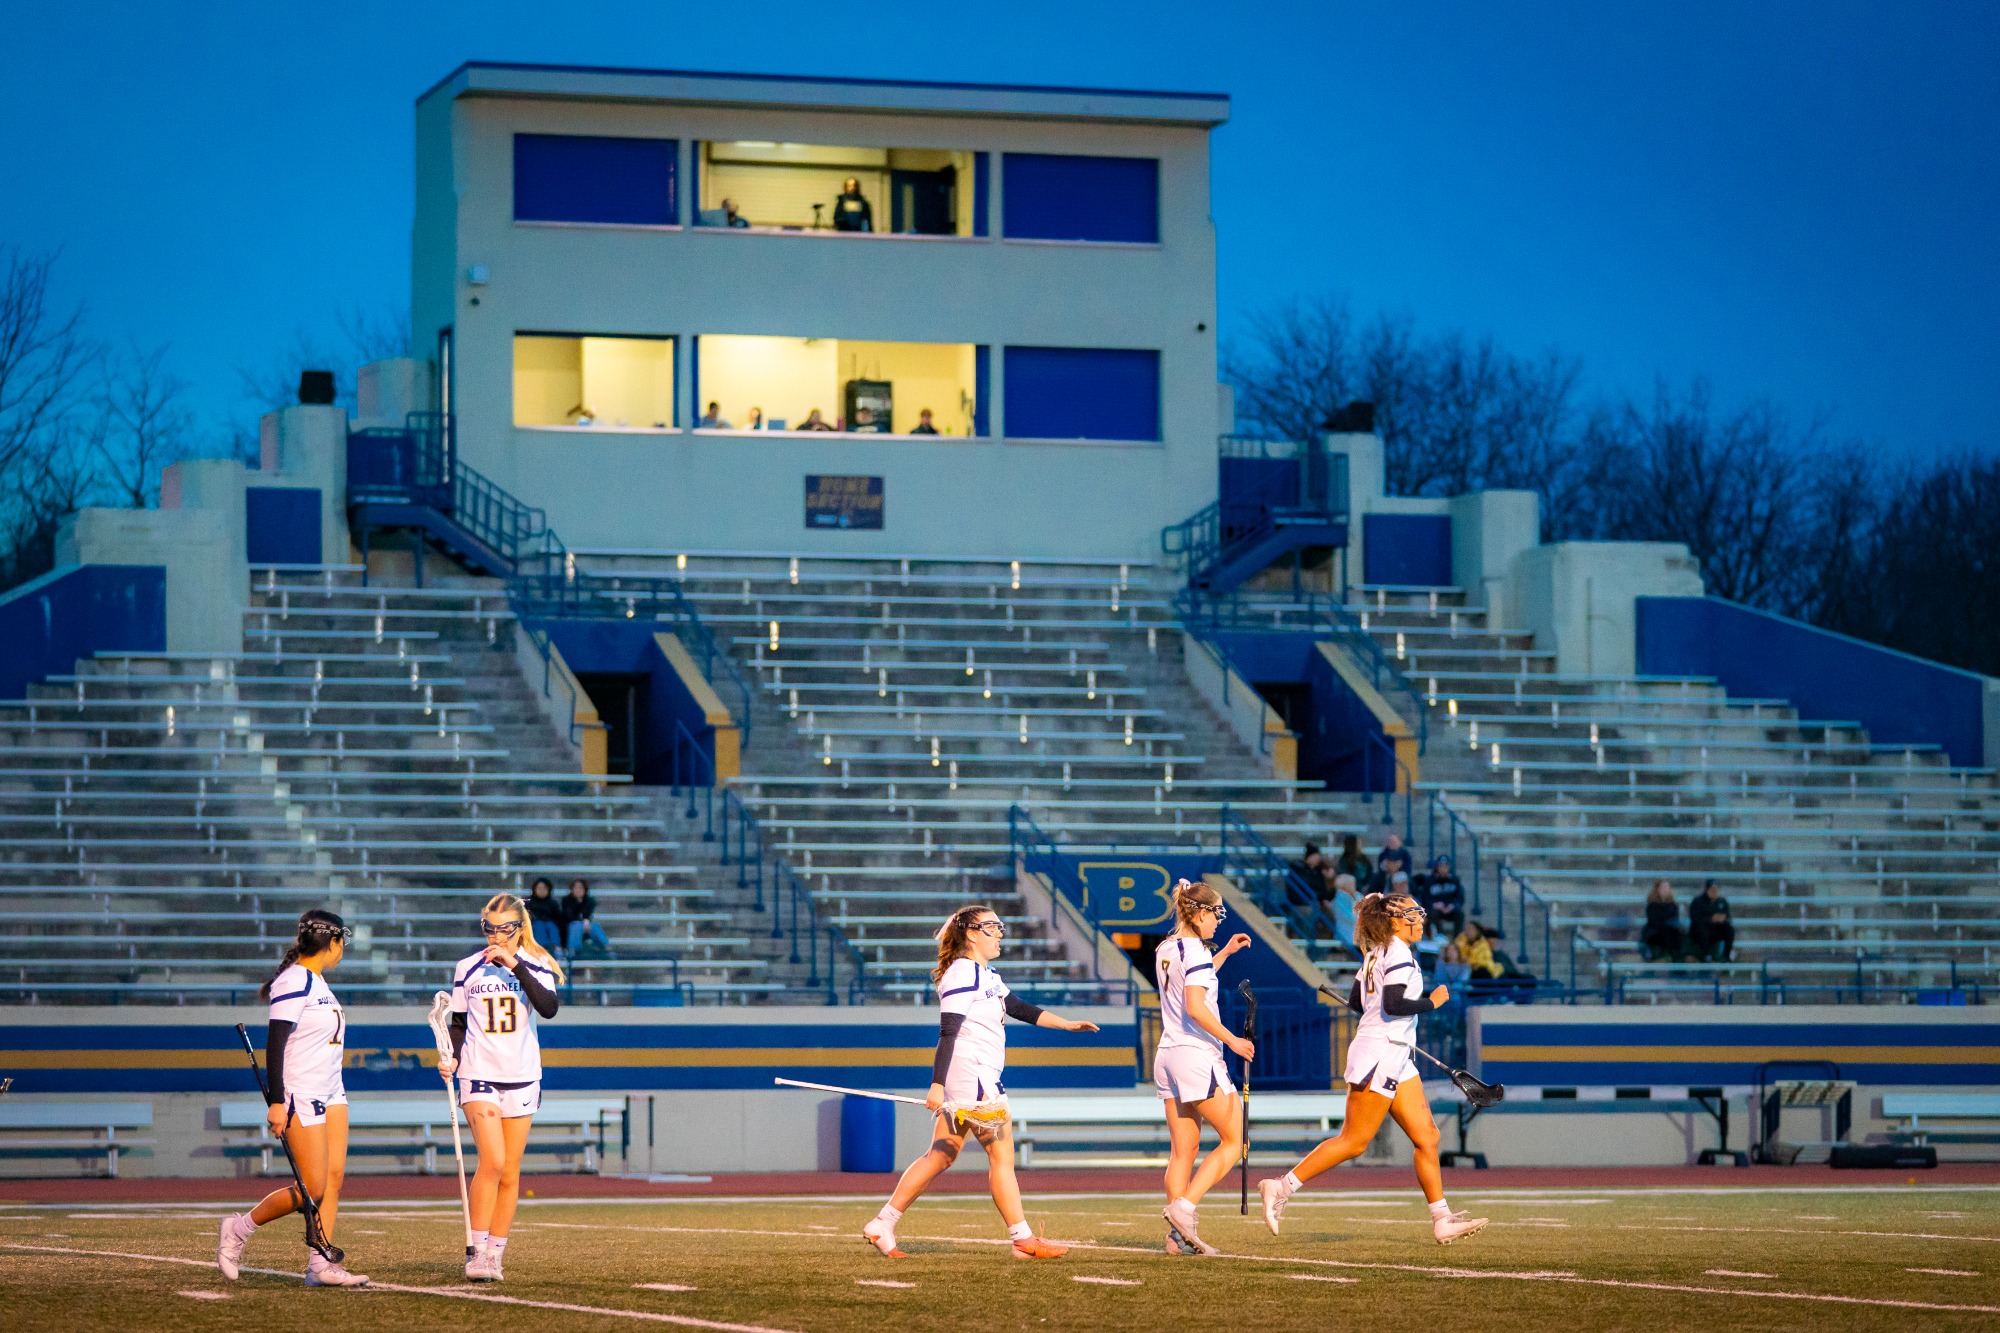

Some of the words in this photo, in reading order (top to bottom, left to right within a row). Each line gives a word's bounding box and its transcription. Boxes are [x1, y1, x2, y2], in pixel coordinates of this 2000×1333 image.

[1078, 861, 1173, 926] B
[470, 982, 523, 995] BUCCANEE
[483, 996, 517, 1035] 13
[470, 1080, 494, 1094] B
[1382, 1076, 1399, 1092] B
[310, 1099, 326, 1117] B
